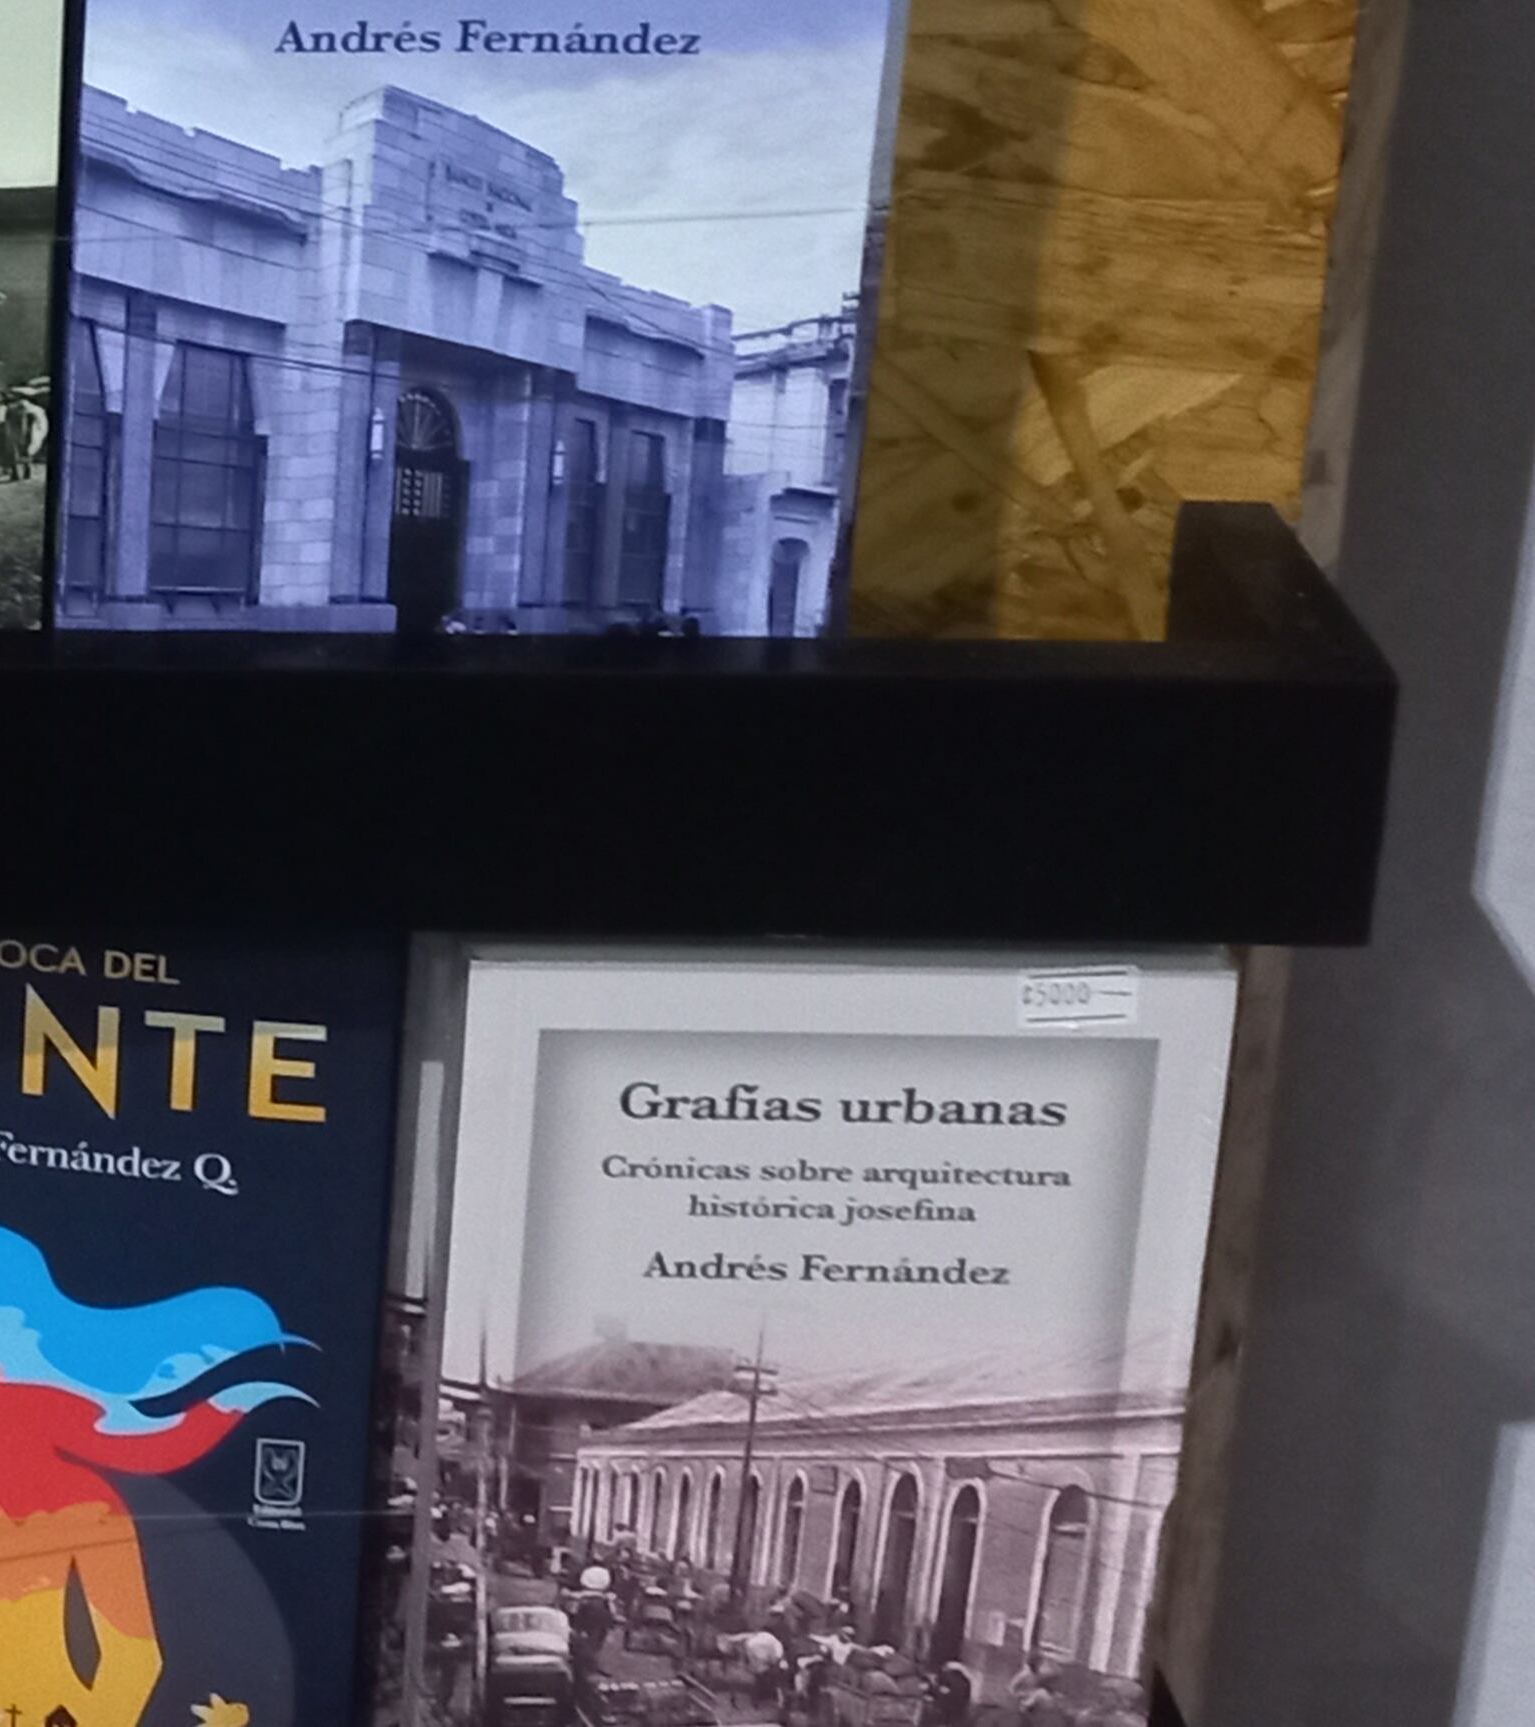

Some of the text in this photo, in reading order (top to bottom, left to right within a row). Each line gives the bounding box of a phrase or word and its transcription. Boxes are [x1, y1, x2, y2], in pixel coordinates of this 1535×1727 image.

[274, 19, 701, 56] Andrés Fernández
[104, 949, 180, 985] DEL
[839, 1087, 1067, 1127] urbanas
[601, 1154, 1071, 1191] Crónicas sobre arquitectura
[688, 1193, 977, 1227] histórica josefina
[643, 1251, 1009, 1285] Andrés Fernández
